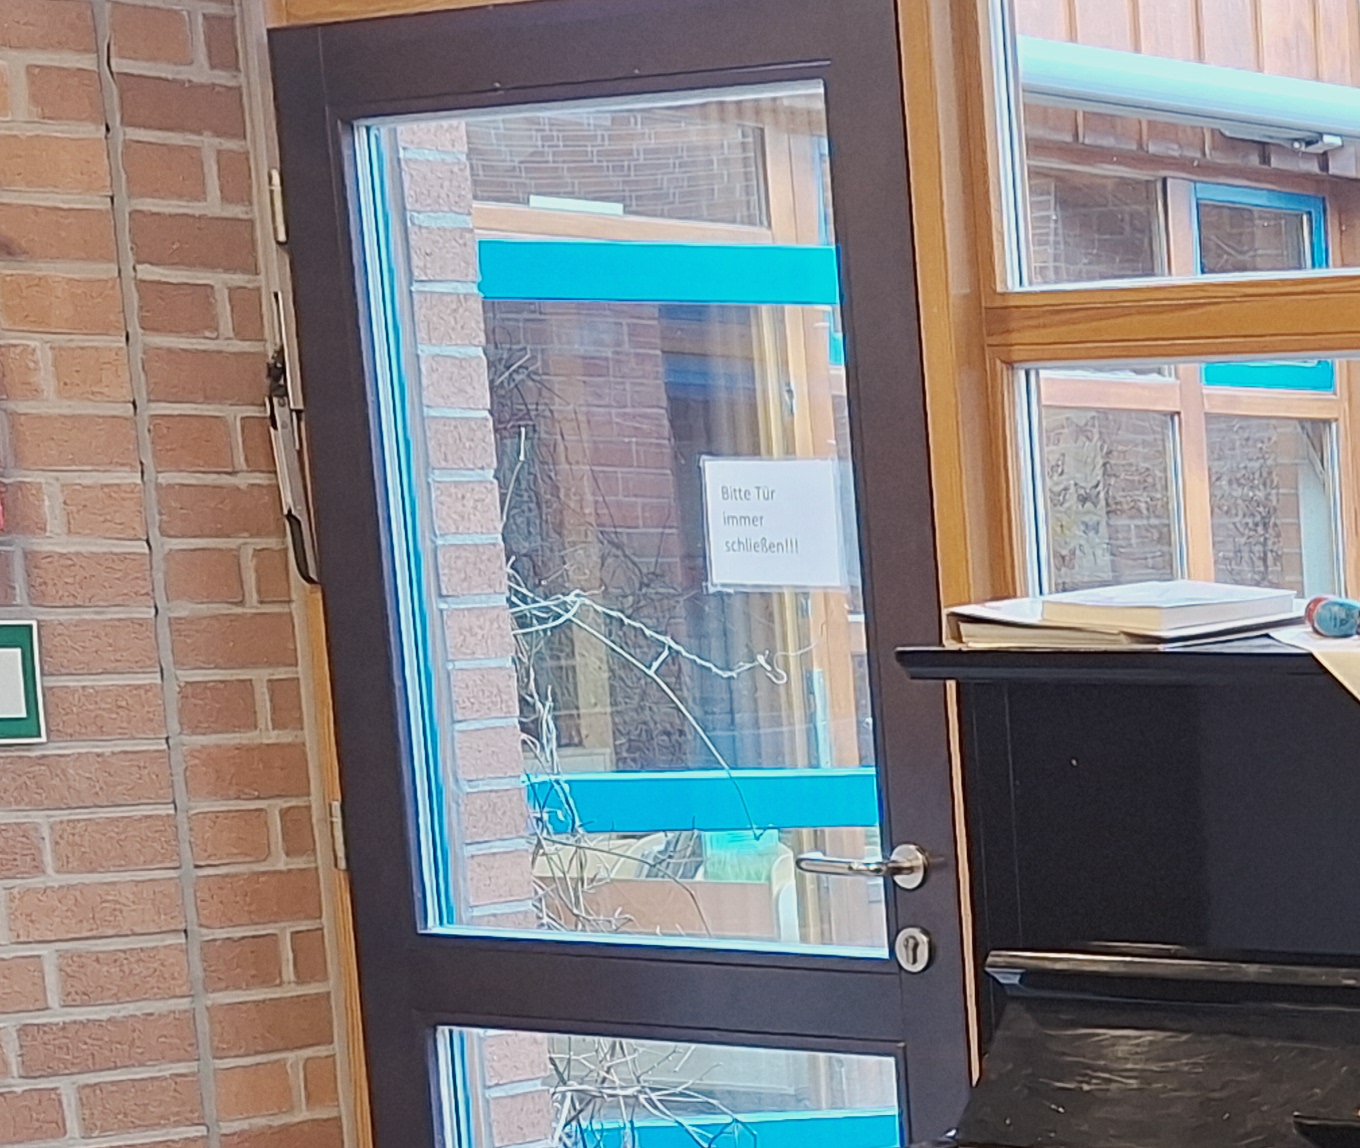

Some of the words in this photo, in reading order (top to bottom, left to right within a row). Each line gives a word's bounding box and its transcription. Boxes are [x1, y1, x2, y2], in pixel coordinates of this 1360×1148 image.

[721, 486, 751, 501] Bitte
[755, 486, 776, 501] Tür
[723, 511, 764, 527] immer
[725, 538, 799, 554] schließen!!!
